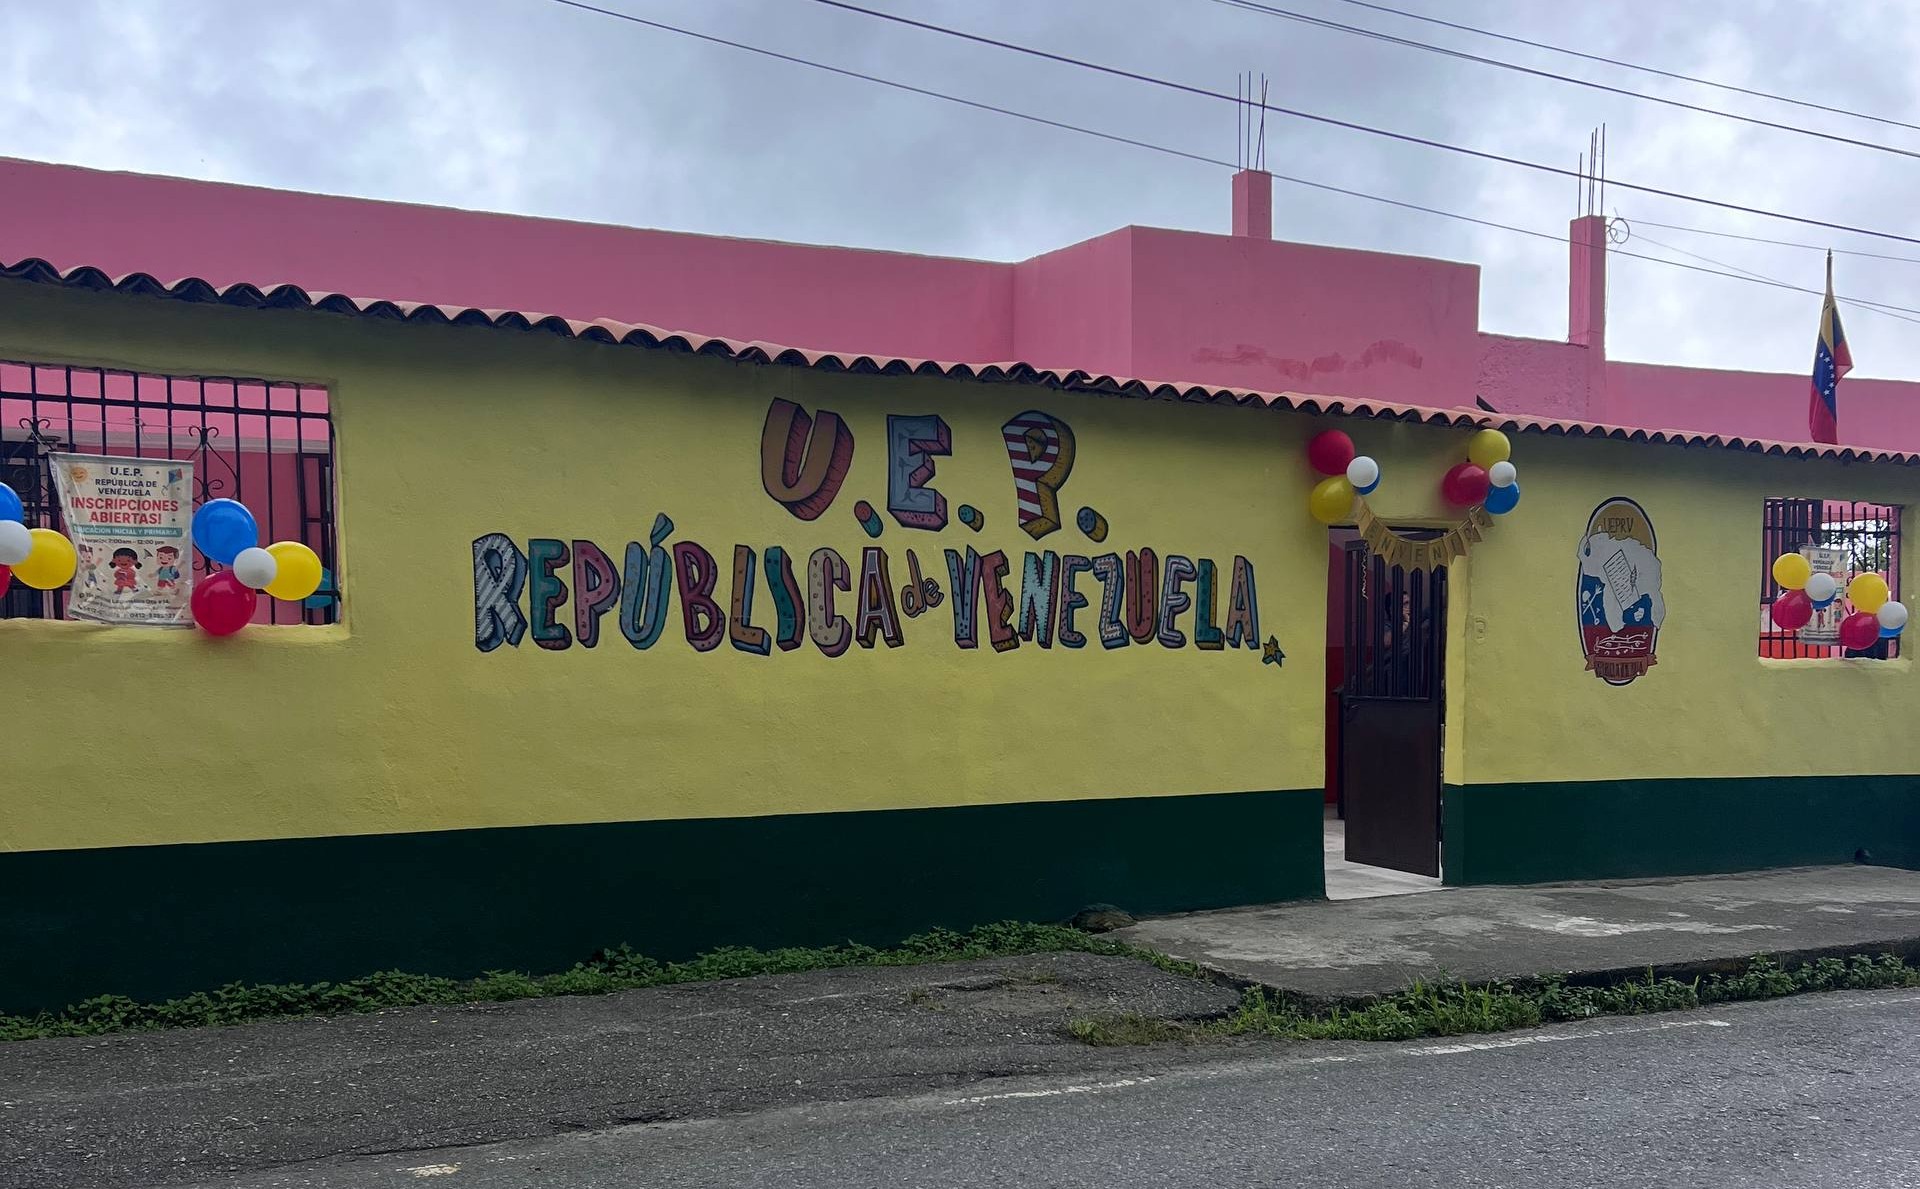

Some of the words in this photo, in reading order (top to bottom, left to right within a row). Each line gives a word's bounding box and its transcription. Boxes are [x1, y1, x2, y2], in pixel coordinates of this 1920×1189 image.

[110, 467, 143, 477] U.E.P.
[95, 477, 144, 488] REPÚBLICA
[98, 488, 151, 496] VENEZUELA
[71, 497, 179, 512] INSCRIPCIONES
[89, 512, 162, 525] ABIERTAS!
[1602, 517, 1634, 534] UEPRV
[472, 513, 906, 658] REPÚBLICA
[900, 548, 945, 619] de
[944, 545, 1262, 654] VENEZUELA
